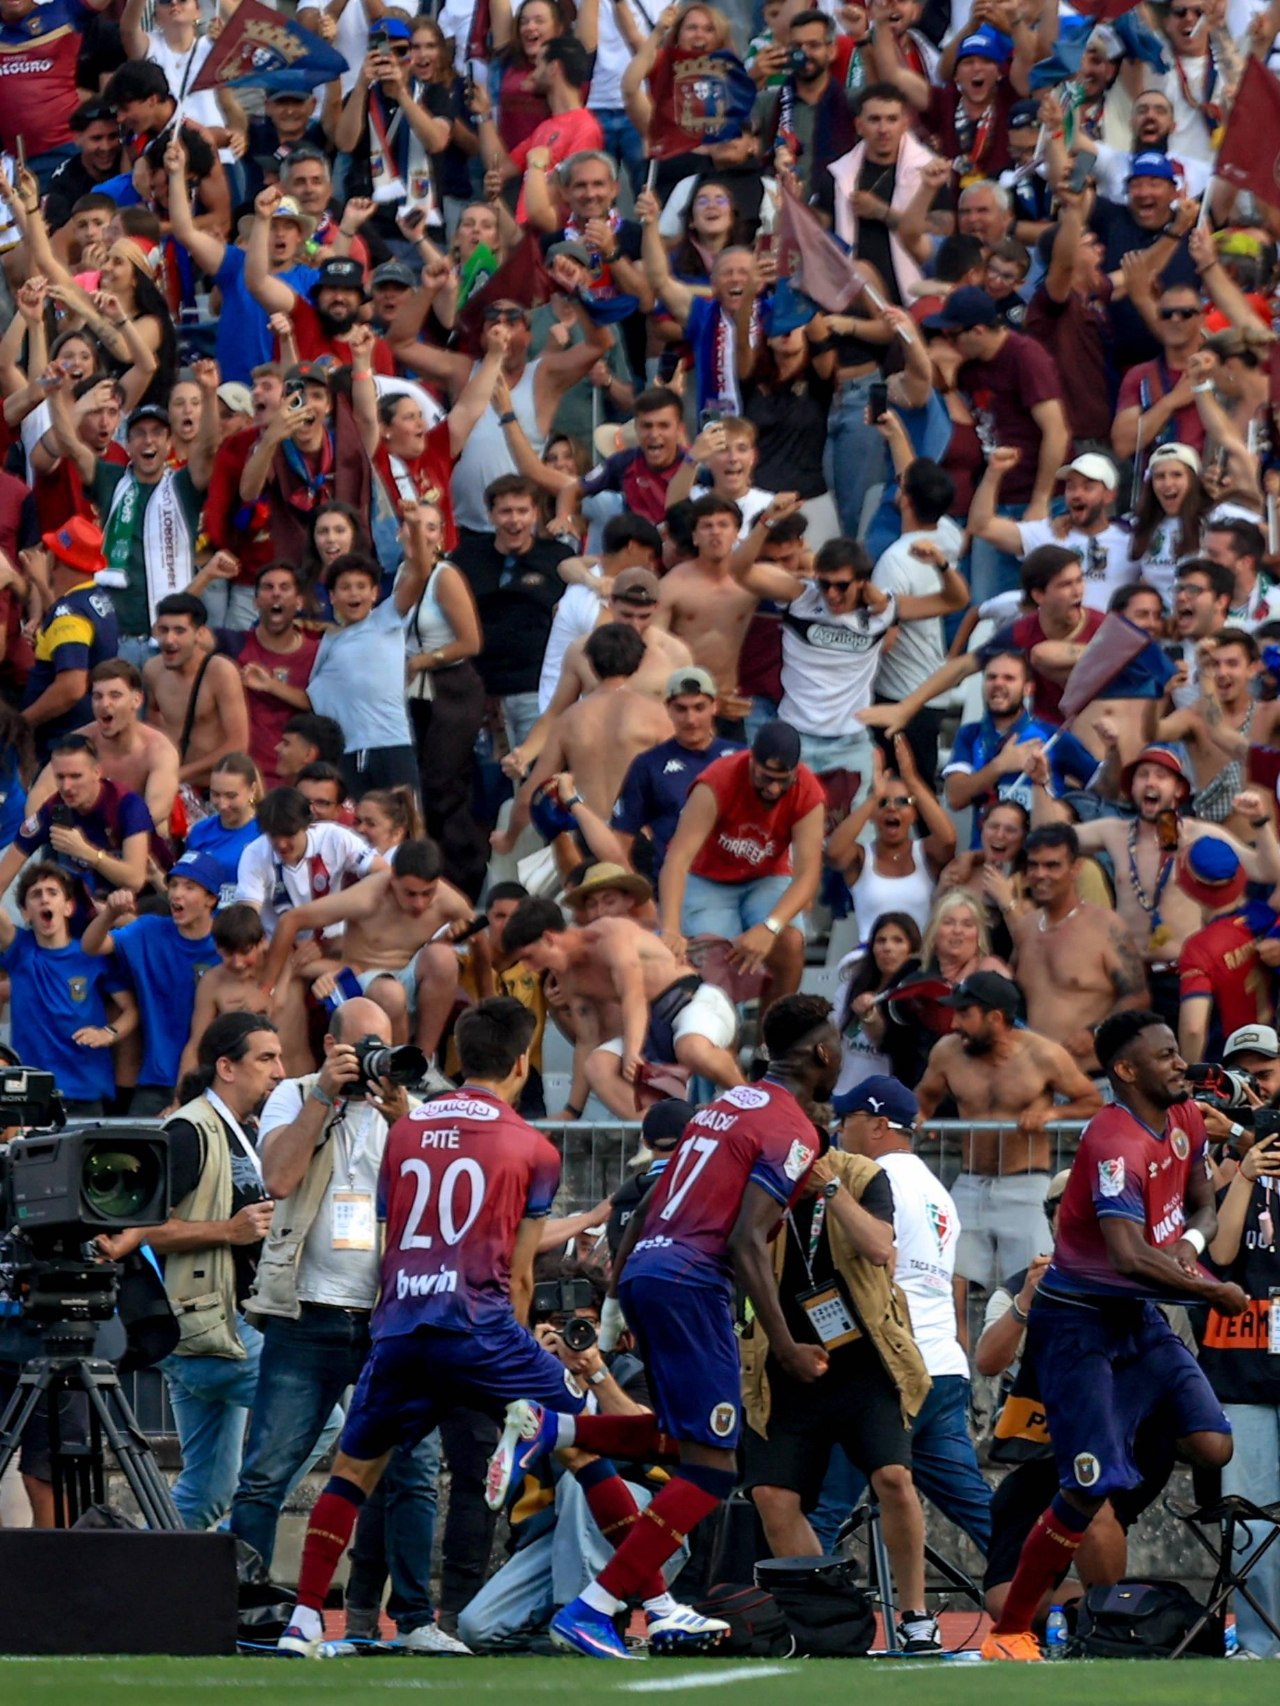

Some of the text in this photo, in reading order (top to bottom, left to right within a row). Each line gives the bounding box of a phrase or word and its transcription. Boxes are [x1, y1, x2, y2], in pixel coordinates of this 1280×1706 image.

[421, 1126, 460, 1149] PITÉ
[399, 1157, 486, 1250] 20
[660, 1136, 719, 1221] 17
[397, 1263, 458, 1300] bwin
